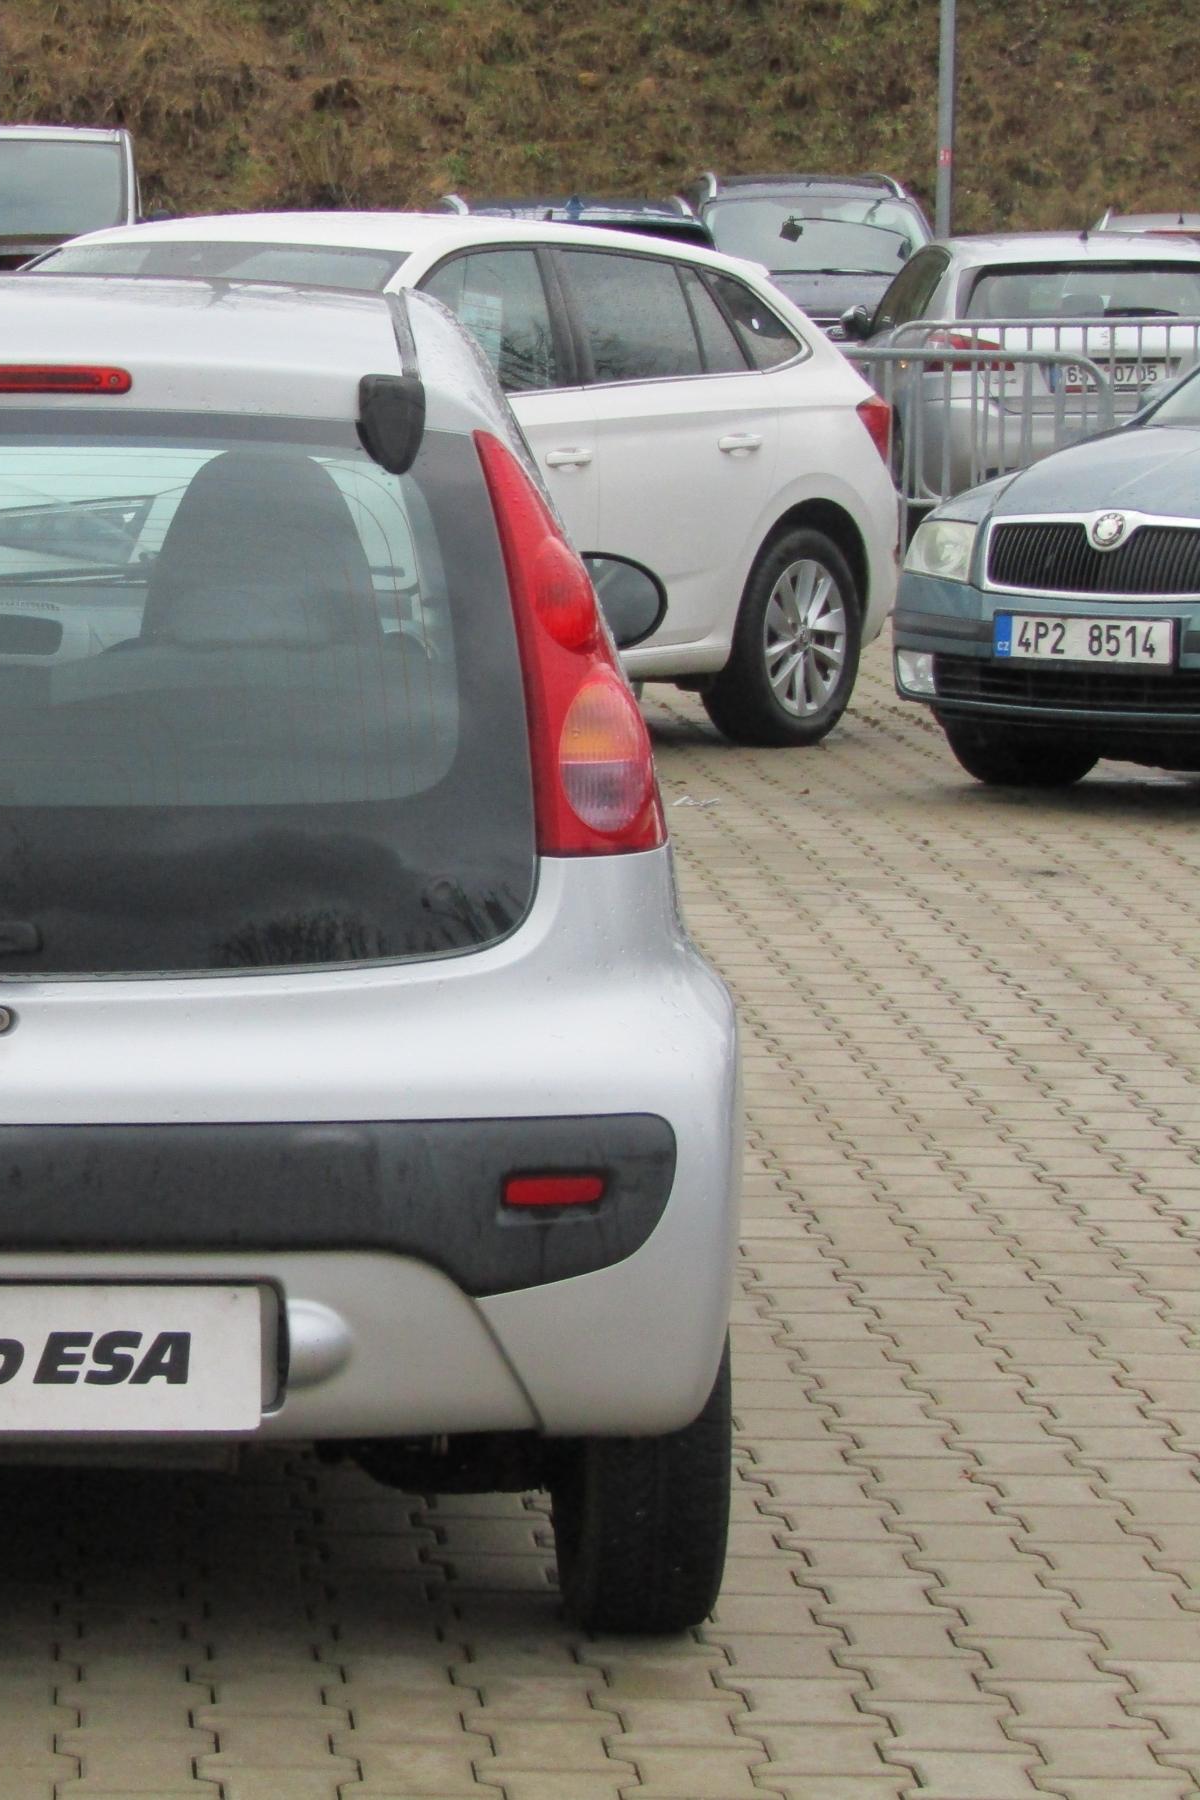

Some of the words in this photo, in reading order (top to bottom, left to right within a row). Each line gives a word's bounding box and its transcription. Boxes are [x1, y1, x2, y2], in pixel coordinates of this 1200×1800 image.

[1114, 364, 1158, 382] 0705
[997, 641, 1009, 650] CZ
[1017, 621, 1066, 654] 4P2
[1088, 624, 1156, 658] 8514
[32, 1330, 192, 1386] ESA
